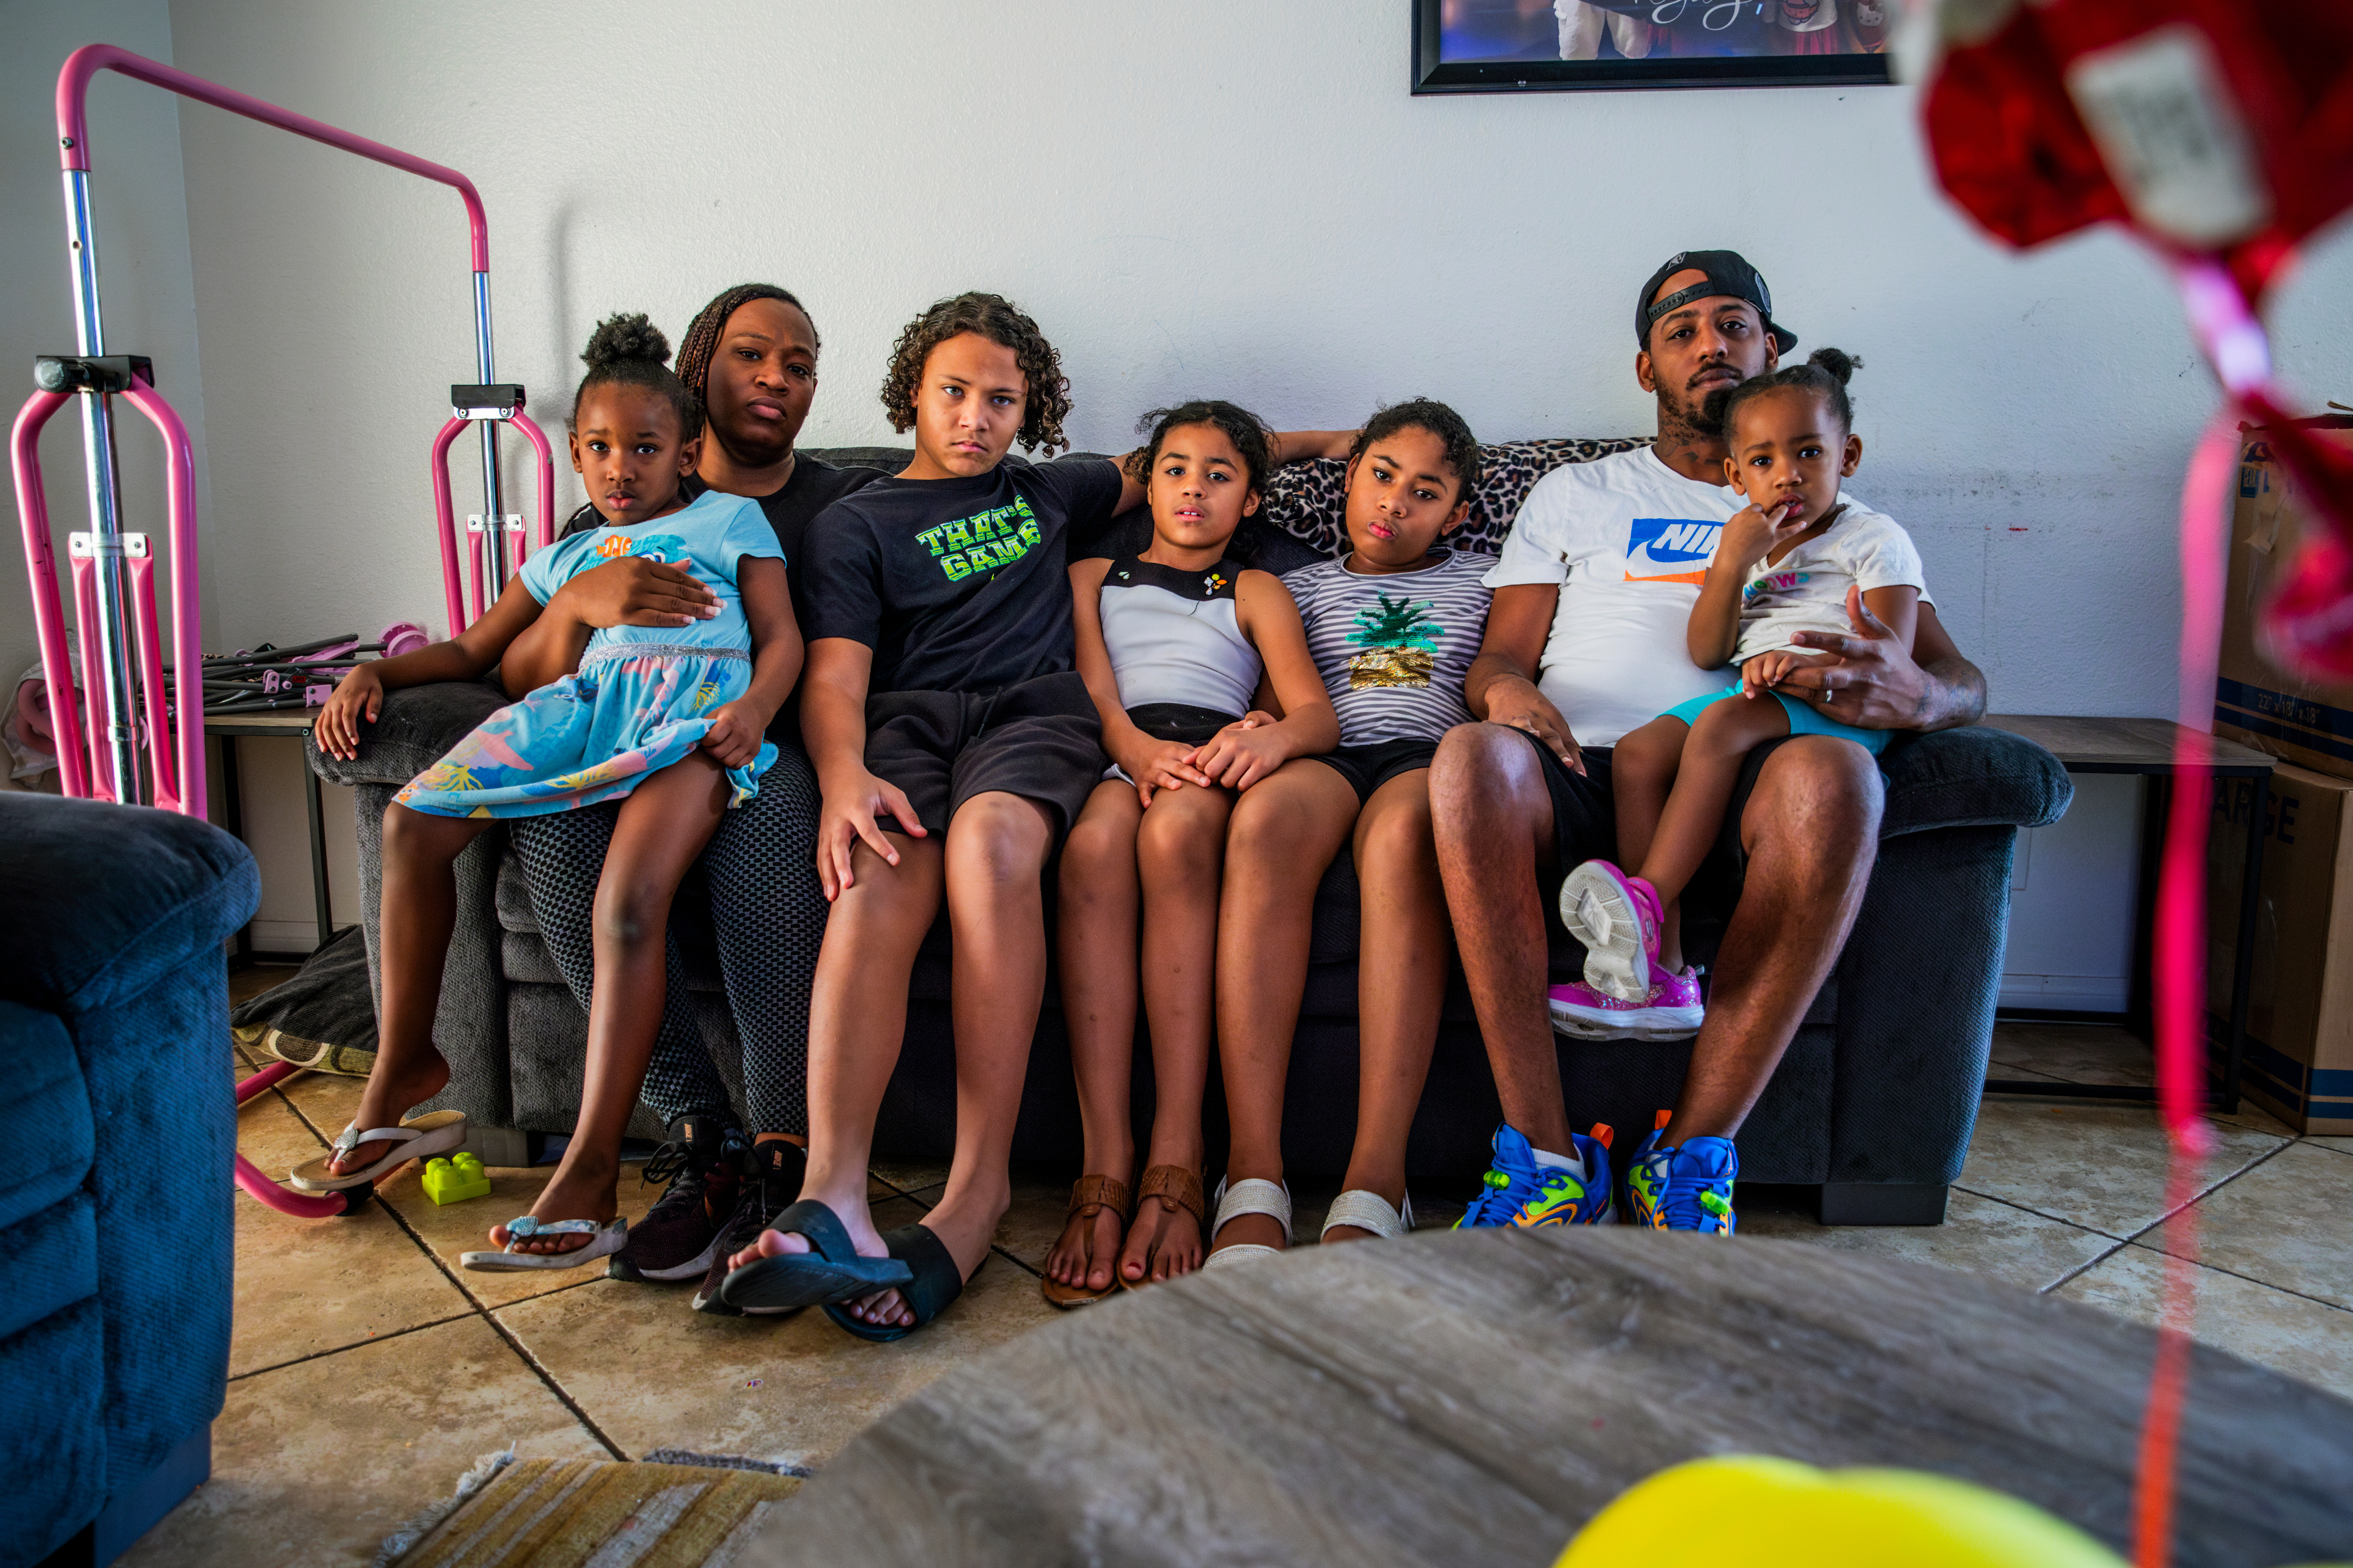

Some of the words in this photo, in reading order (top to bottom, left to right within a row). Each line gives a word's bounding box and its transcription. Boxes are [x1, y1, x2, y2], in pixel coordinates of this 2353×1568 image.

[915, 495, 1035, 556] THAT'S
[940, 519, 1041, 582] GAME
[2212, 778, 2299, 845] ARGE
